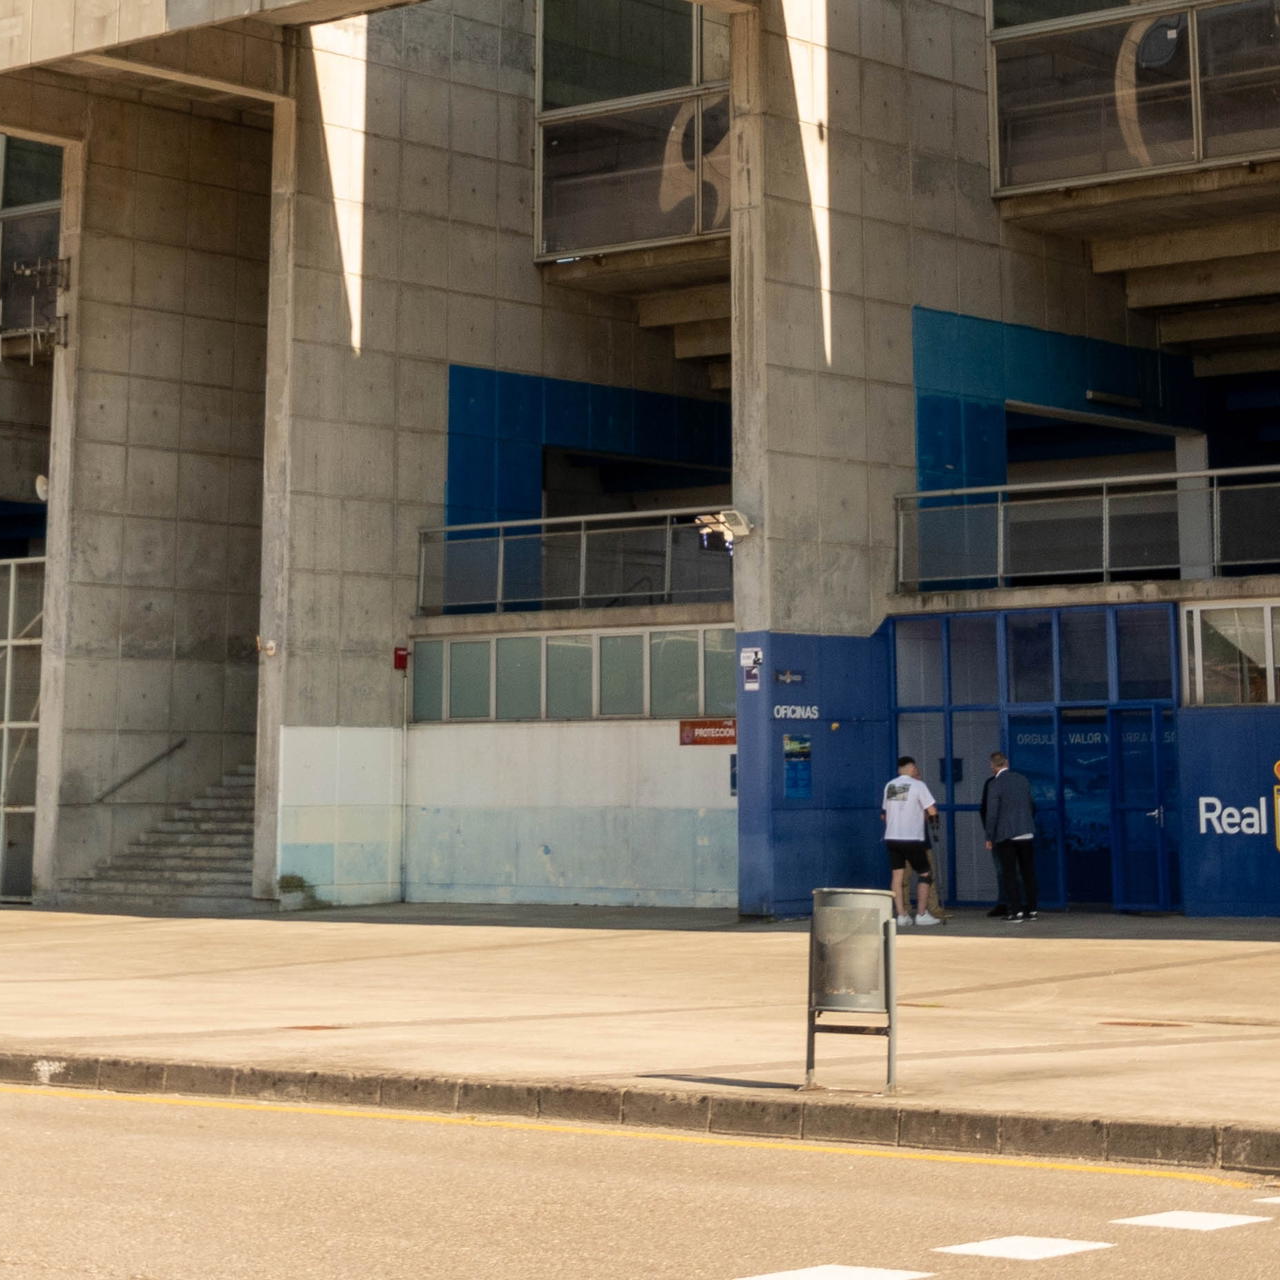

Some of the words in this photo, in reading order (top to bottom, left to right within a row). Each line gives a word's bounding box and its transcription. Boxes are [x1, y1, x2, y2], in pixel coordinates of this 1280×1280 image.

[773, 705, 819, 719] OFICINAS
[1069, 732, 1101, 744] VALOR
[1198, 796, 1268, 835] Real
